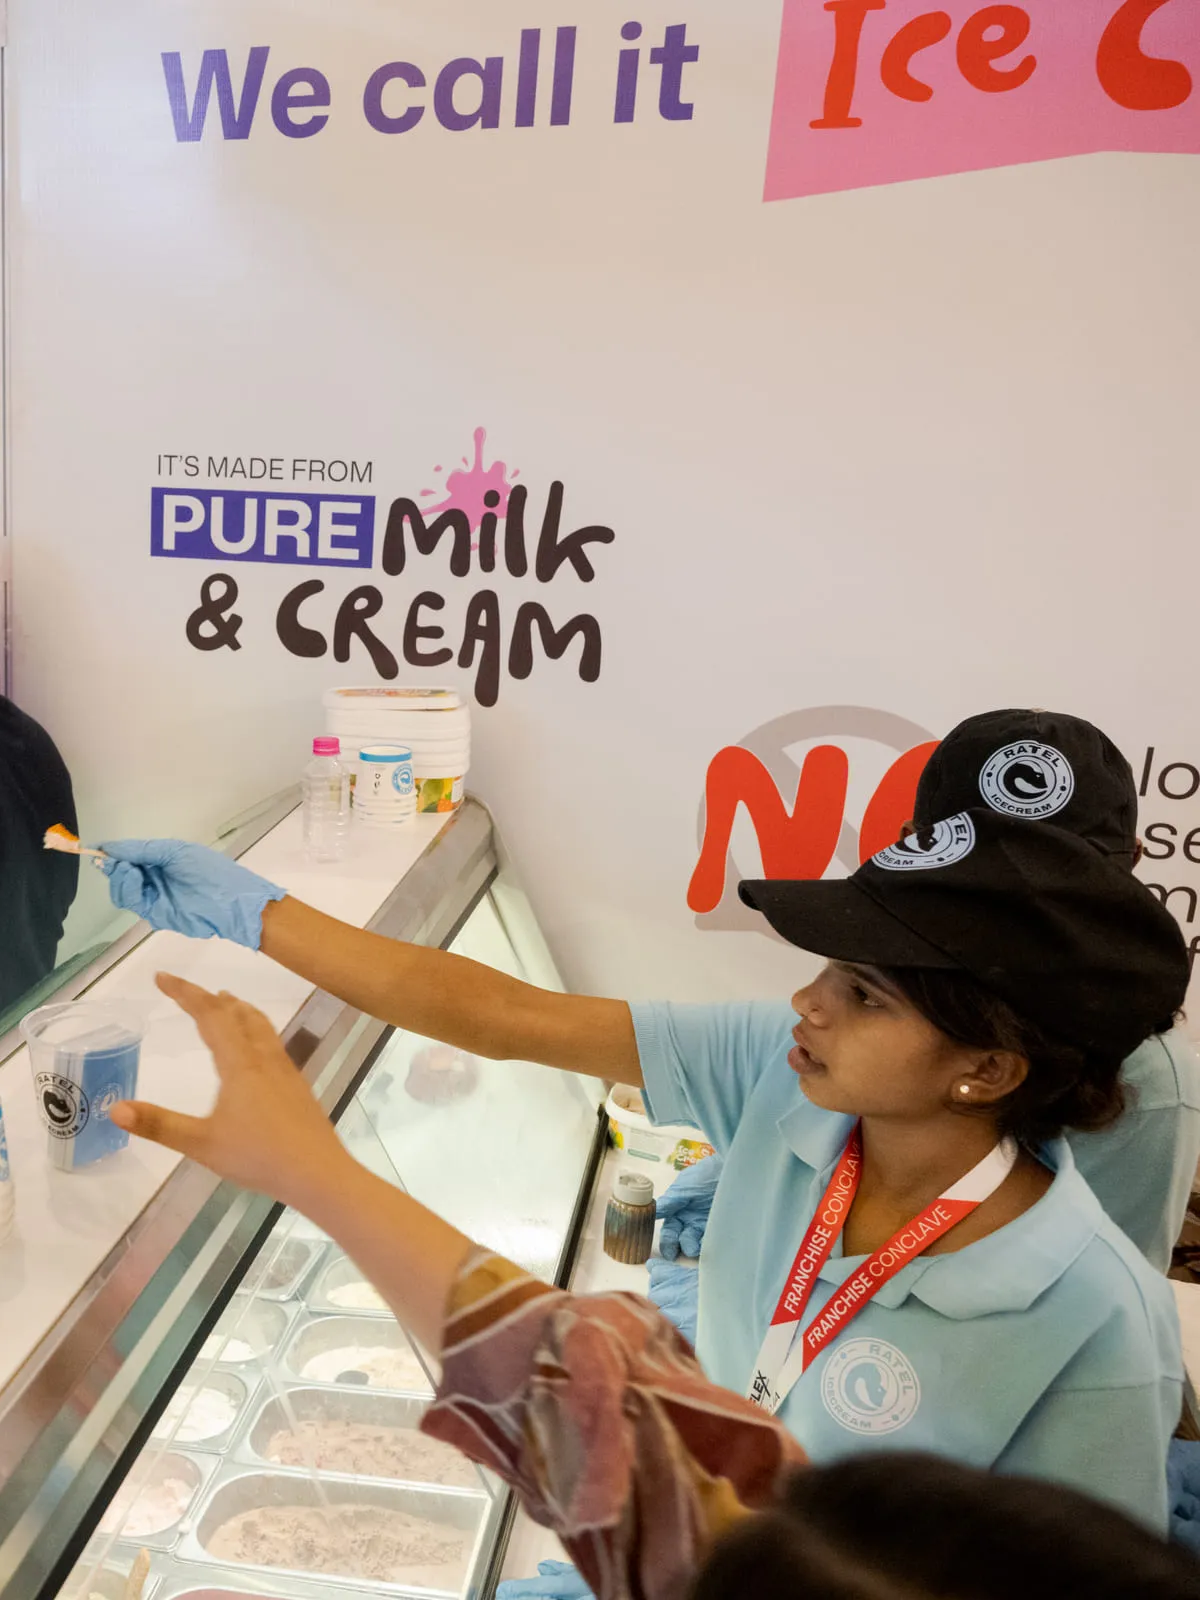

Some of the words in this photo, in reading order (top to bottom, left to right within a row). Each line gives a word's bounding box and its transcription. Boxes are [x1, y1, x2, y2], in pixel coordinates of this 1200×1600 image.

[160, 46, 331, 143] We
[363, 26, 577, 135] call
[613, 20, 700, 124] it
[809, 0, 1037, 129] Ice
[157, 454, 200, 478] IT'S
[207, 456, 284, 481] MADE
[291, 459, 373, 483] FROM
[162, 494, 362, 561] PURE
[186, 572, 243, 651] &
[276, 579, 602, 707] CREAM
[1003, 745, 1061, 768] RATEL
[950, 815, 968, 846] TEL
[991, 794, 1052, 815] ICECREAM
[879, 851, 914, 865] CREAM
[38, 1075, 75, 1094] RATEL
[784, 1225, 832, 1314] FRANCHISE
[807, 1272, 873, 1348] FRANCHISE
[868, 1204, 952, 1278] CONCLAVE
[868, 1344, 915, 1396] RATEL
[828, 1376, 872, 1429] ICECREAM
